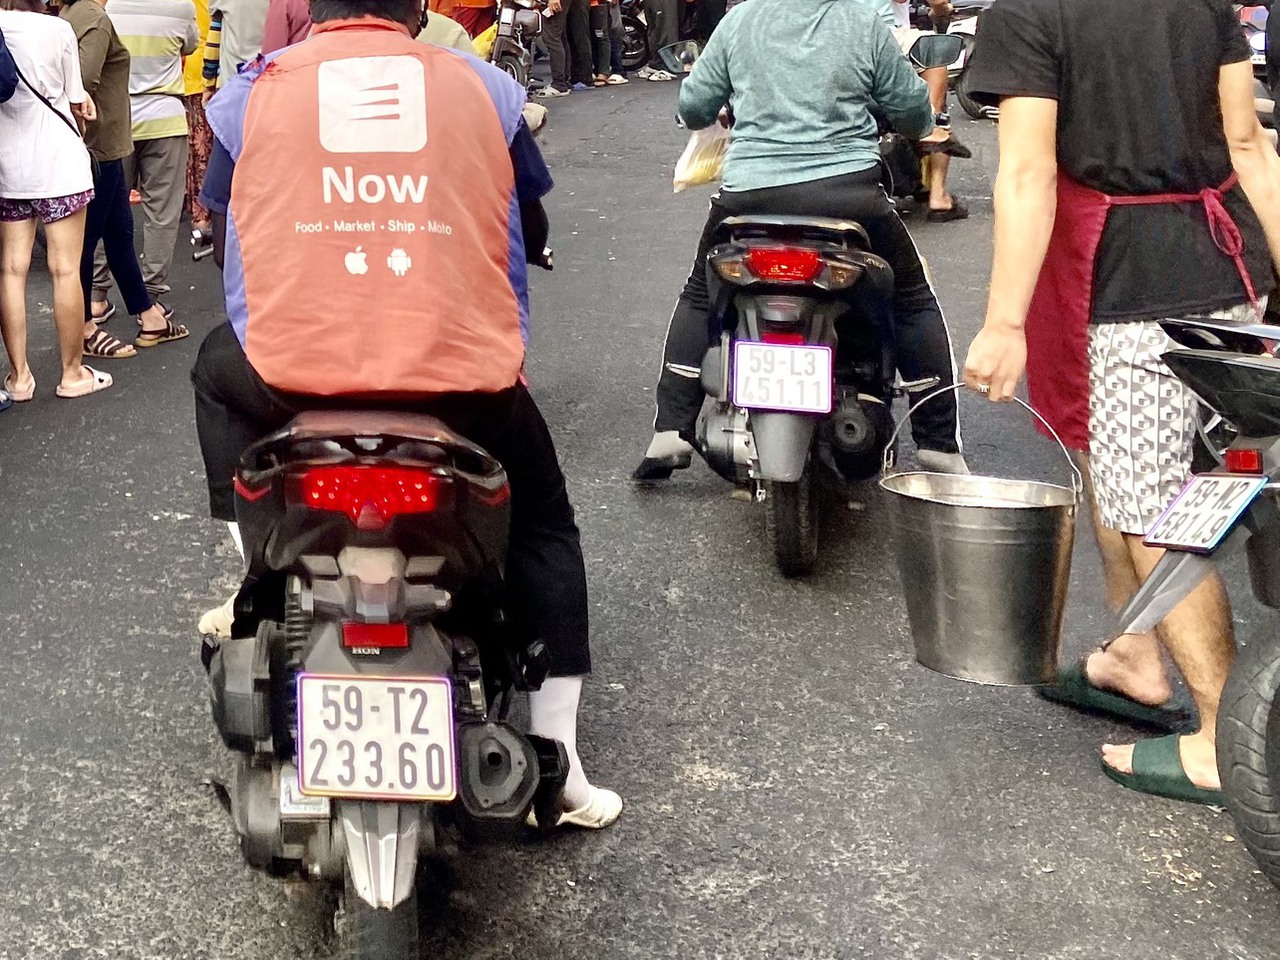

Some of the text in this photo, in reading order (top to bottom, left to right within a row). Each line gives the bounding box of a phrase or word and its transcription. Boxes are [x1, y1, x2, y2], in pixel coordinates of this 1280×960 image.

[322, 166, 429, 204] Now
[295, 219, 453, 235] Food Market Ship Moto
[748, 347, 817, 376] 59-L3
[742, 376, 822, 407] 451.11
[322, 684, 430, 735] 59-T2
[309, 738, 446, 791] 233.60
